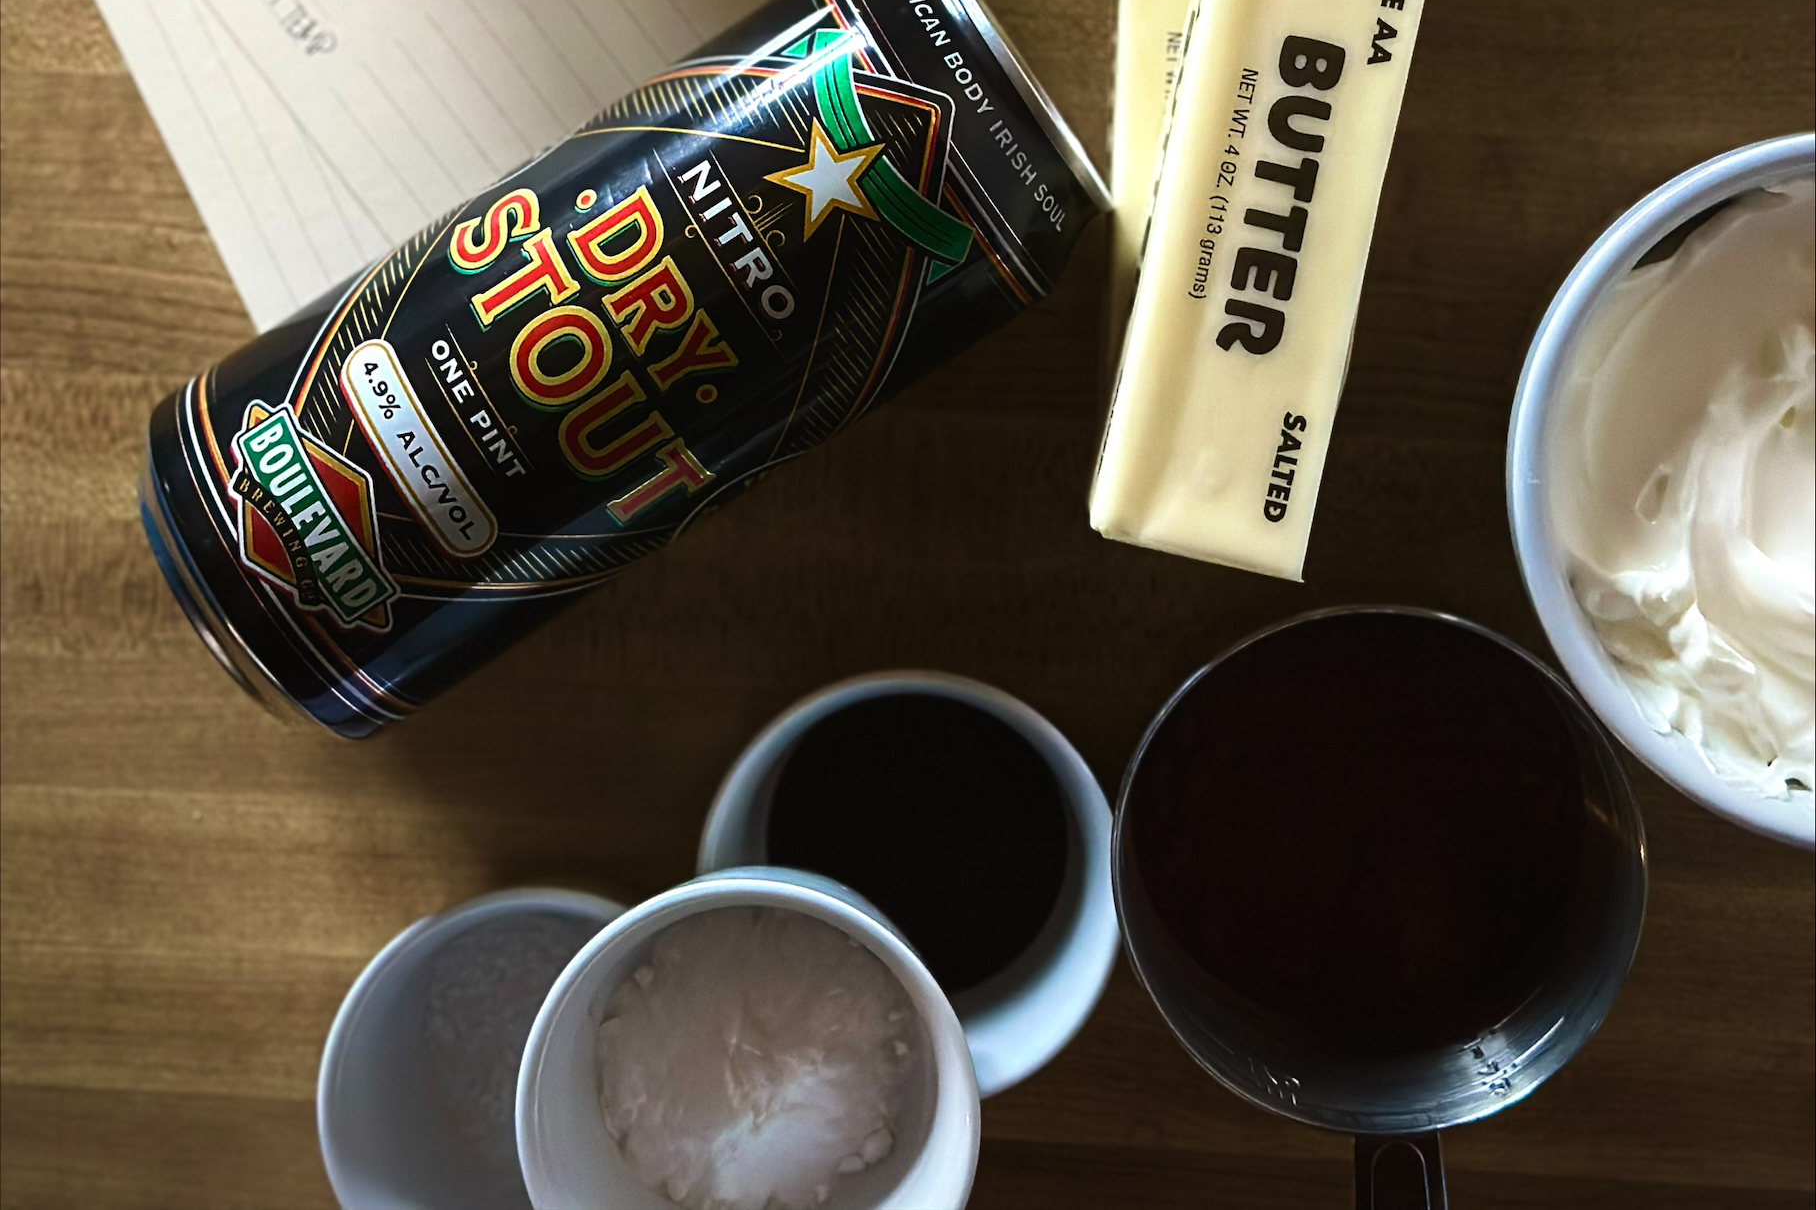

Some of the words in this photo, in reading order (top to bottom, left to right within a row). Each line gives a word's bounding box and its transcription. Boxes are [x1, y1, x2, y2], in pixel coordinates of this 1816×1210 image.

[1236, 67, 1259, 105] NET
[1366, 16, 1395, 67] AA
[943, 51, 995, 114] BODY
[989, 119, 1037, 186] IRISH
[1033, 184, 1067, 232] SOUL
[1216, 160, 1238, 189] OZ.
[1223, 144, 1241, 156] 4
[1228, 108, 1251, 140] WT.
[678, 159, 796, 321] NITRO
[1206, 195, 1230, 236] (113
[1214, 34, 1347, 358] BUTTER
[567, 184, 740, 392] DRY
[1187, 237, 1216, 301] grams)
[431, 339, 475, 405] ONE
[469, 409, 526, 479] PINT
[448, 188, 717, 526] STOUT
[363, 356, 402, 421] 4.9%
[396, 430, 479, 541] ALC/VOL
[1263, 410, 1308, 524] SALTED
[238, 477, 309, 569] BREWING
[249, 422, 379, 608] BOULEVARD
